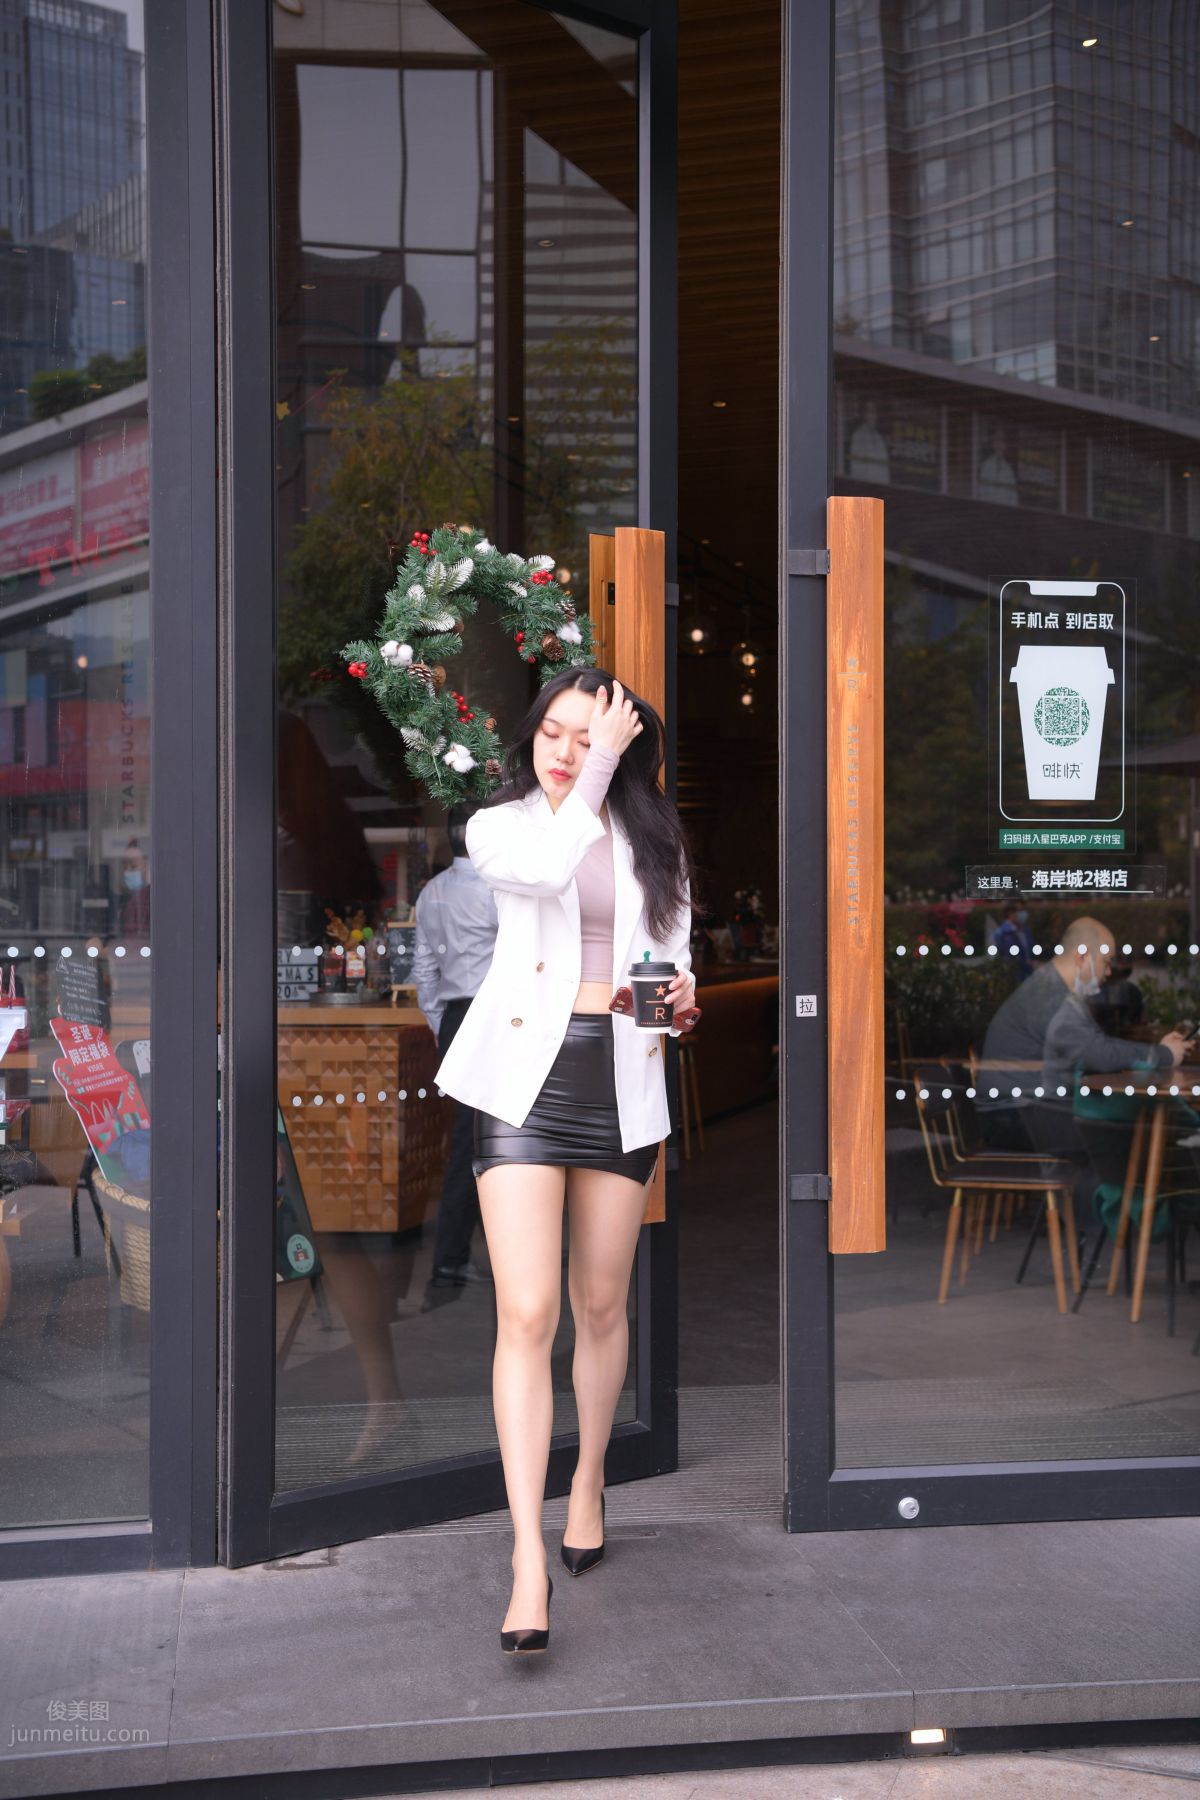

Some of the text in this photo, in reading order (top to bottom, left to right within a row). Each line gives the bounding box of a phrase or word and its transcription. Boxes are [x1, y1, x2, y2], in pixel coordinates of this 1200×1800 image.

[1011, 612, 1114, 630] 手机点 到店取
[122, 702, 134, 824] STARBUCKS
[1042, 762, 1081, 779] 啡快
[1003, 833, 1087, 845] 扫码进入星巴克APP
[848, 815, 858, 926] STARBUCKS
[1031, 869, 1128, 888] 海岸城2楼店
[655, 1007, 665, 1020] R
[799, 998, 814, 1014] 拉
